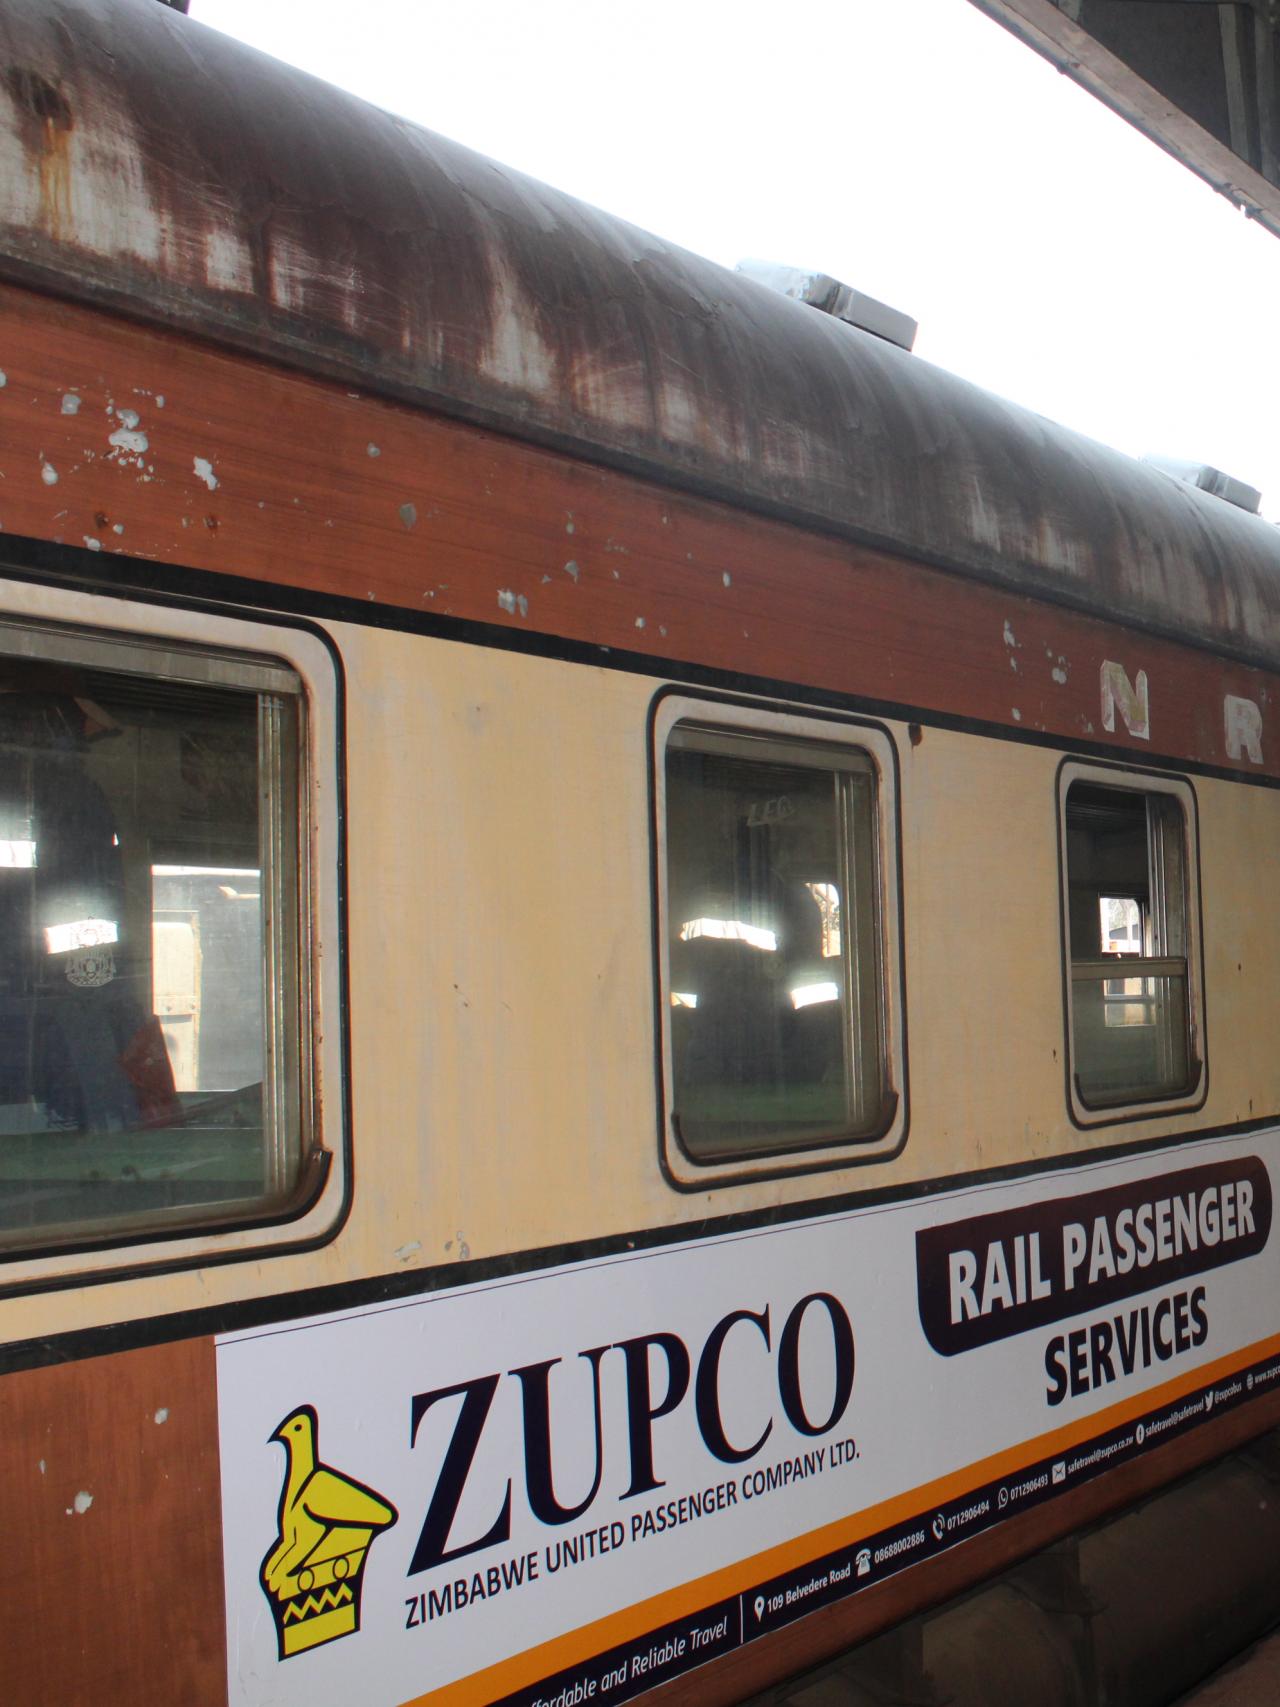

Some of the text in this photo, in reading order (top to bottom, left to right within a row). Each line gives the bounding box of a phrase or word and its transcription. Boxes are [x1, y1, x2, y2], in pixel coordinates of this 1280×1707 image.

[948, 1180, 1256, 1325] RAIL PASSENGER
[1044, 1286, 1209, 1407] SERVICES
[406, 1291, 855, 1577] ZUPCO
[405, 1438, 860, 1630] ZIMBABWE UNITED PASSENGER COMPANY LTD.
[767, 1562, 851, 1613] 109 Belvedere Road
[601, 1661, 627, 1692] and
[631, 1639, 686, 1678] Reliable
[690, 1616, 728, 1650] Travel
